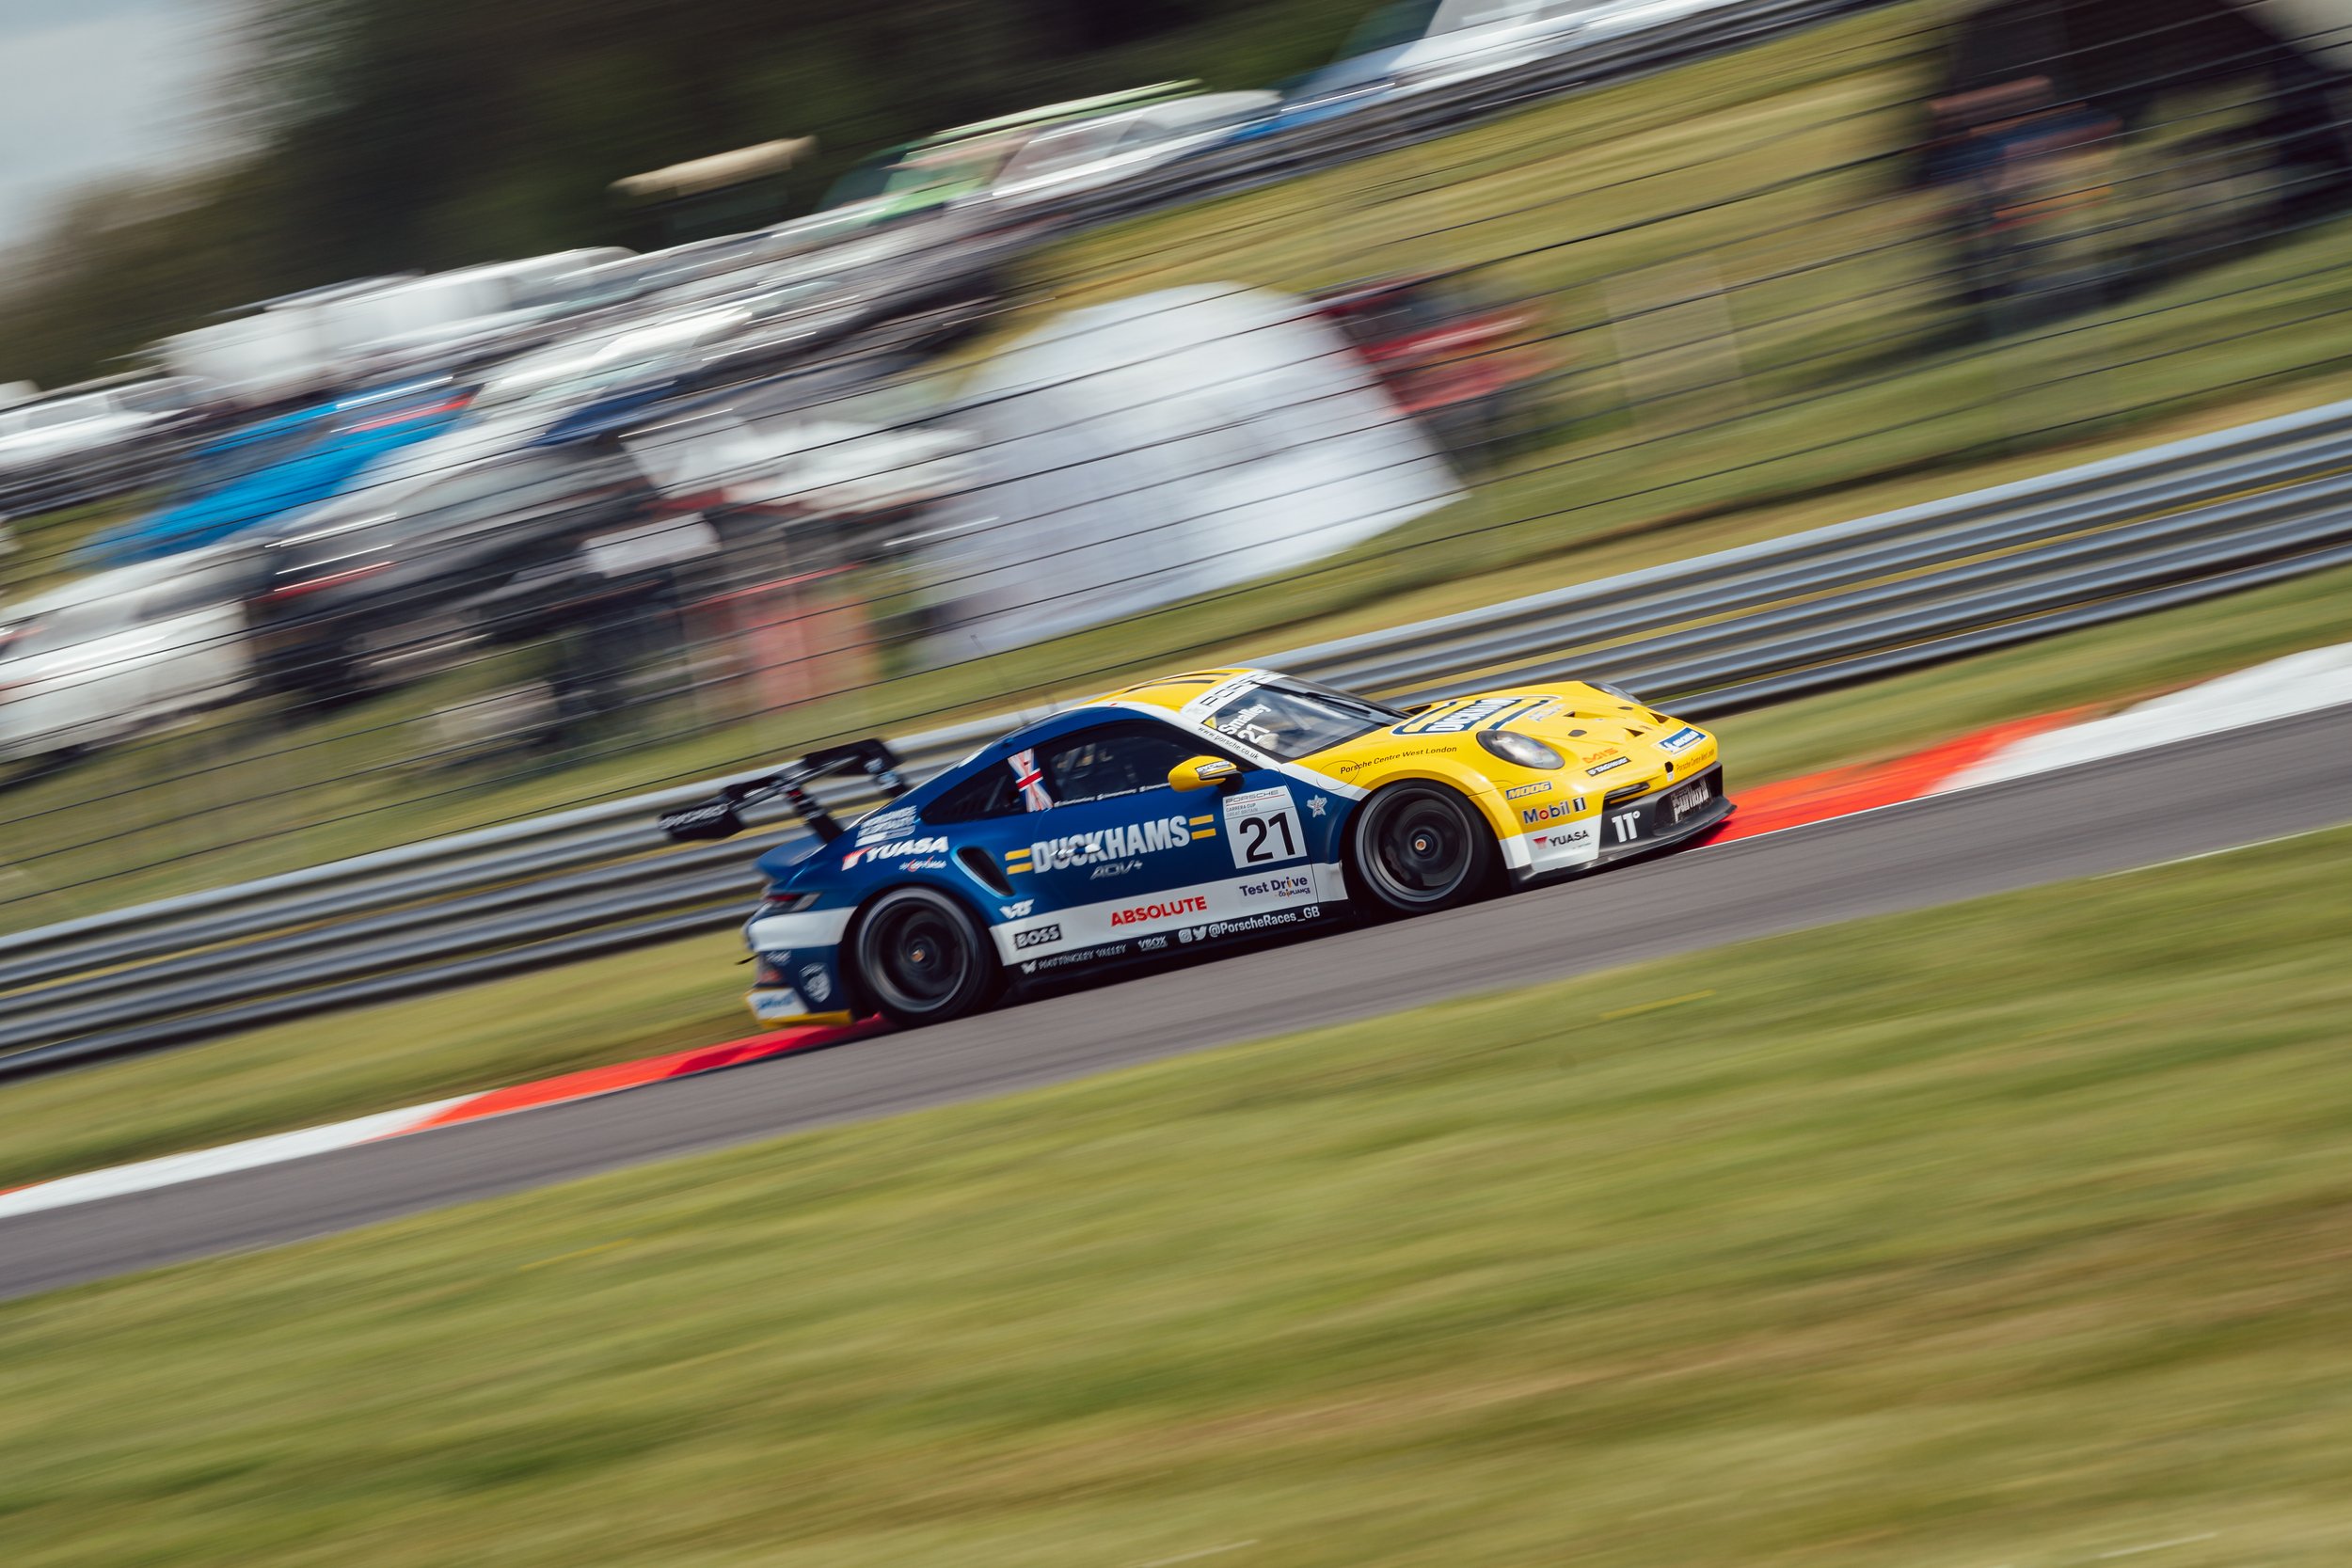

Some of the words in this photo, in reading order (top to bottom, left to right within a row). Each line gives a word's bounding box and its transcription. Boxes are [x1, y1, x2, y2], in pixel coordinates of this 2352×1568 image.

[1217, 704, 1271, 735] Smalley
[1198, 727, 1259, 760] www.porsche.co.uk
[1238, 723, 1270, 743] 21
[1340, 760, 1373, 774] Porsche
[1374, 753, 1401, 765] Centre
[1402, 749, 1423, 757] West
[1226, 790, 1279, 804] PORSCHE
[1507, 783, 1551, 800] MOOG
[1523, 800, 1570, 823] Mobil
[1573, 798, 1586, 812] 1
[866, 836, 949, 863] YUASA
[1030, 815, 1190, 874] DUCKHAMS
[1239, 812, 1295, 863] 21
[1549, 830, 1590, 847] YUASA
[1239, 882, 1269, 896] Test
[1271, 877, 1308, 892] Drive
[1110, 895, 1207, 927] ABSOLUTE
[1208, 906, 1320, 938] @PorscheRaces_GB
[1016, 926, 1059, 947] BOSS
